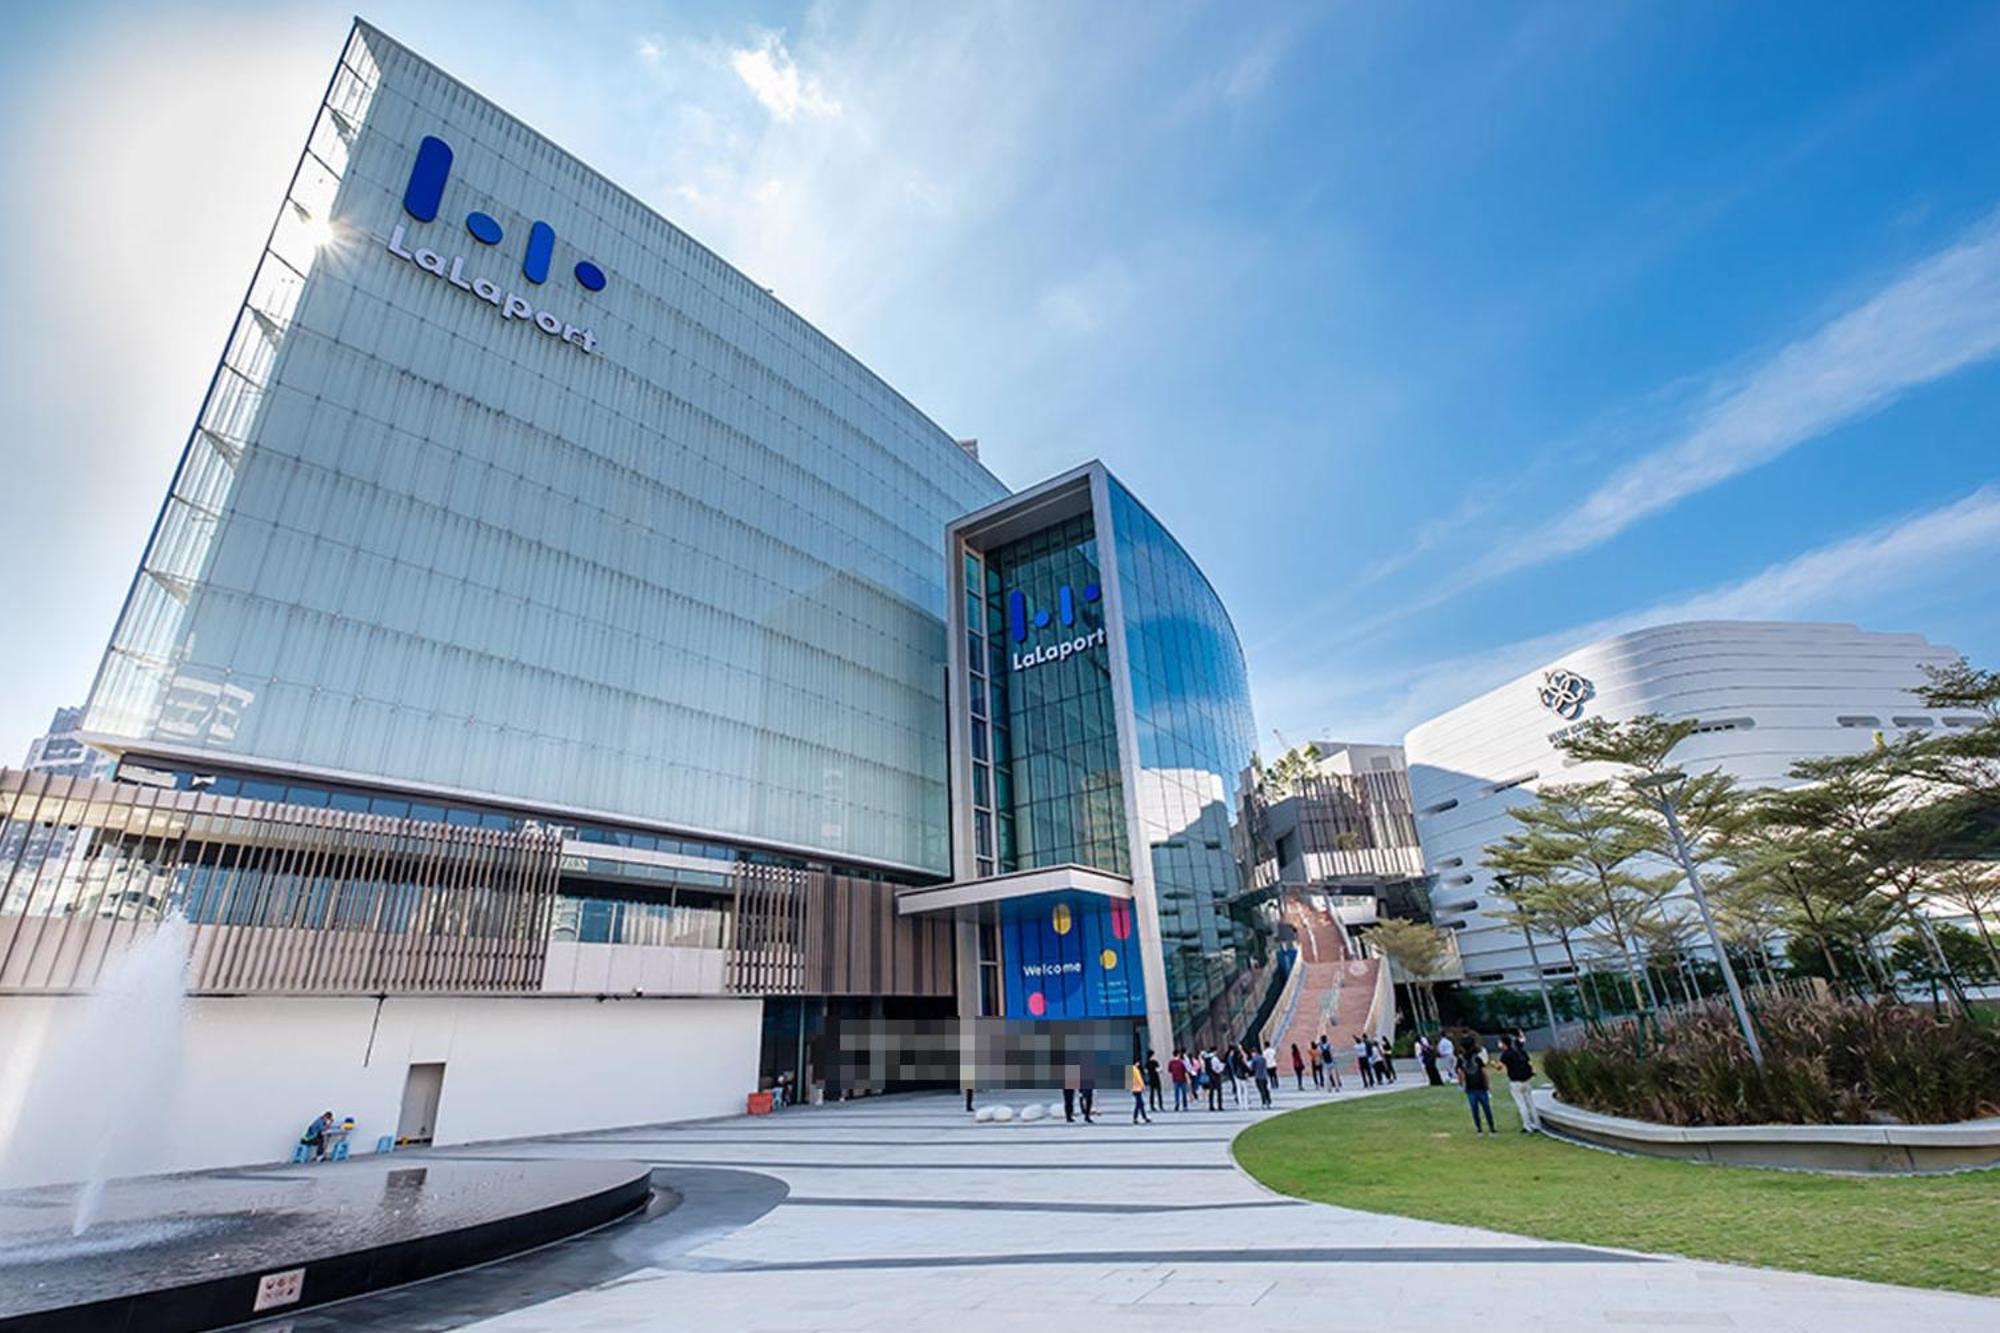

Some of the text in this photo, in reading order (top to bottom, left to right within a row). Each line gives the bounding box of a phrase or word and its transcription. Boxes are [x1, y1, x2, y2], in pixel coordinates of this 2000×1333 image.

[387, 225, 598, 353] LaLaport
[1013, 628, 1105, 670] LaLaport
[1023, 962, 1081, 976] Welcome
